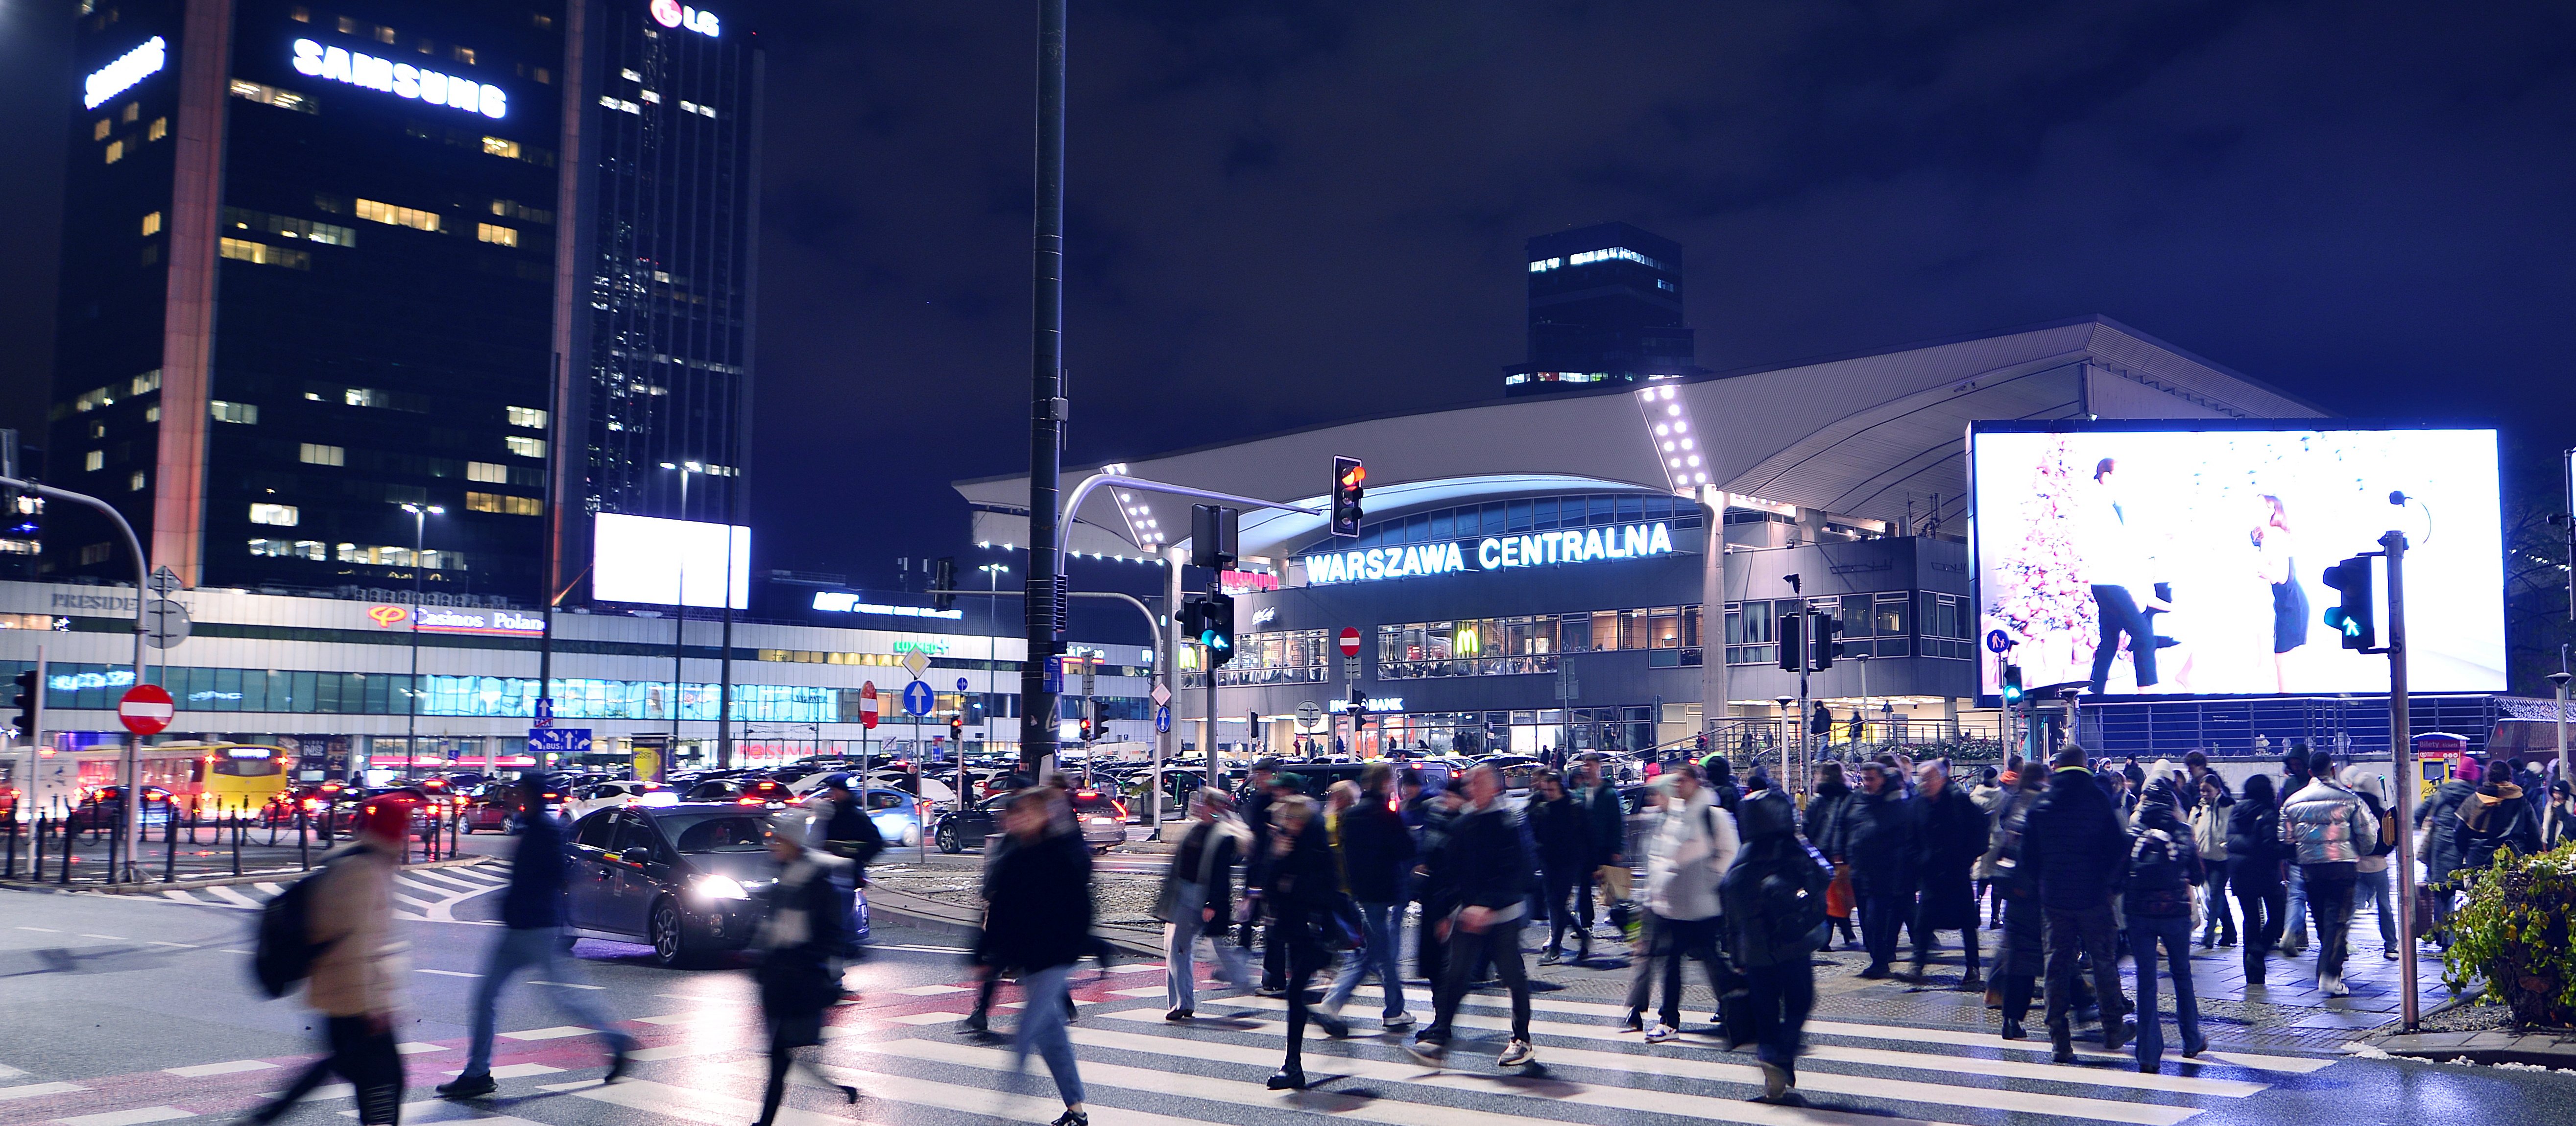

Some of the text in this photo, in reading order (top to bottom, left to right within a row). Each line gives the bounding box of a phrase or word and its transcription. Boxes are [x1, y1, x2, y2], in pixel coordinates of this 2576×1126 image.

[683, 5, 720, 38] LG
[293, 38, 506, 119] SAMSUNG
[1305, 522, 1673, 584] WARSZAWA CENTRALNA
[412, 608, 484, 628] Casinos
[1369, 697, 1403, 711] BANK
[535, 719, 553, 727] TAXI
[739, 744, 841, 759] ROSSMAN
